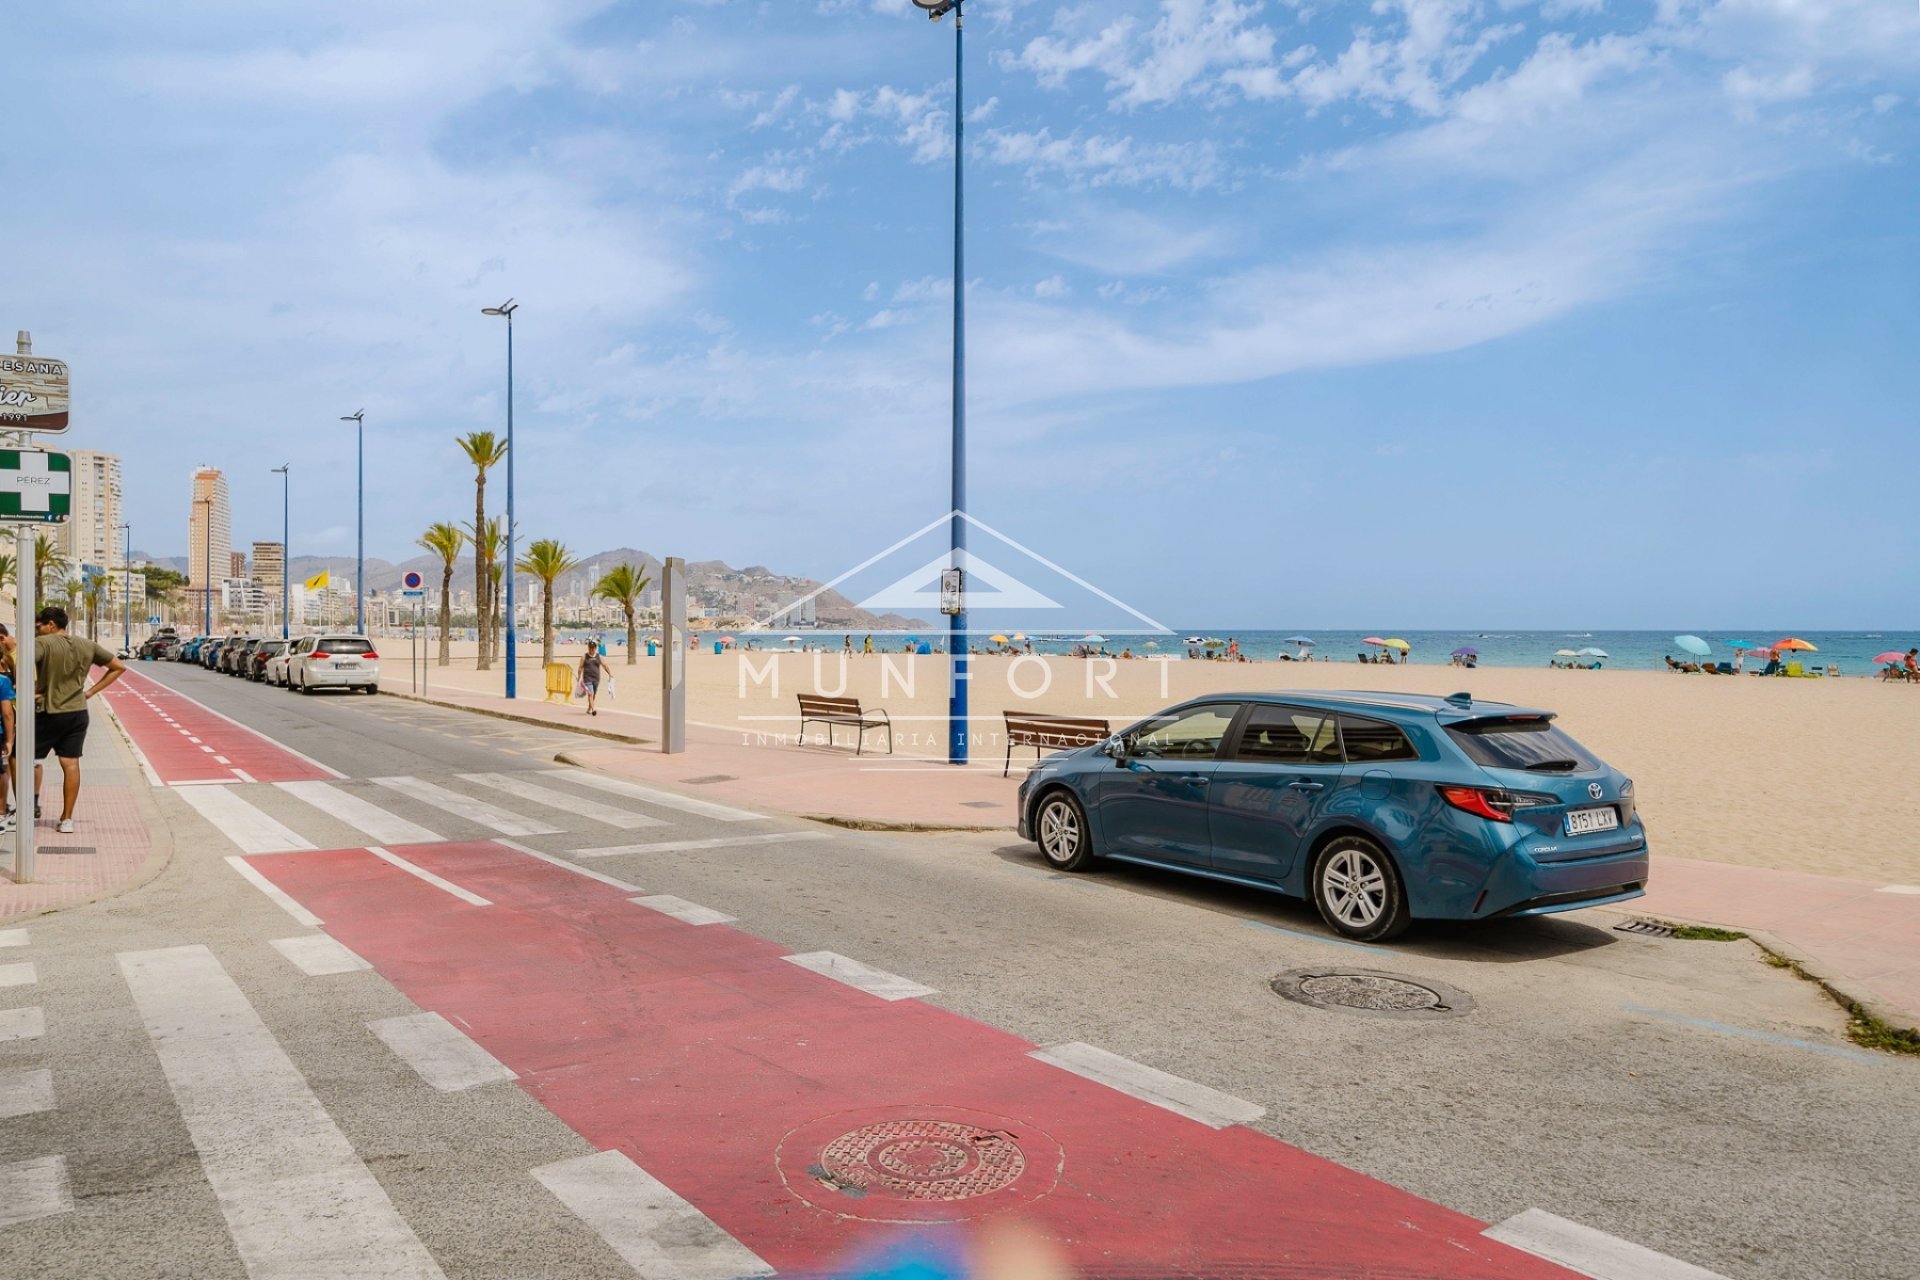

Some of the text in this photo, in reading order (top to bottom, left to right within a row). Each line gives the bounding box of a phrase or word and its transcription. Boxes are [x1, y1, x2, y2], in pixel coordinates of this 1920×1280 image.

[0, 360, 62, 375] ESANA
[2, 413, 28, 421] 1991
[1571, 813, 1594, 830] 8151
